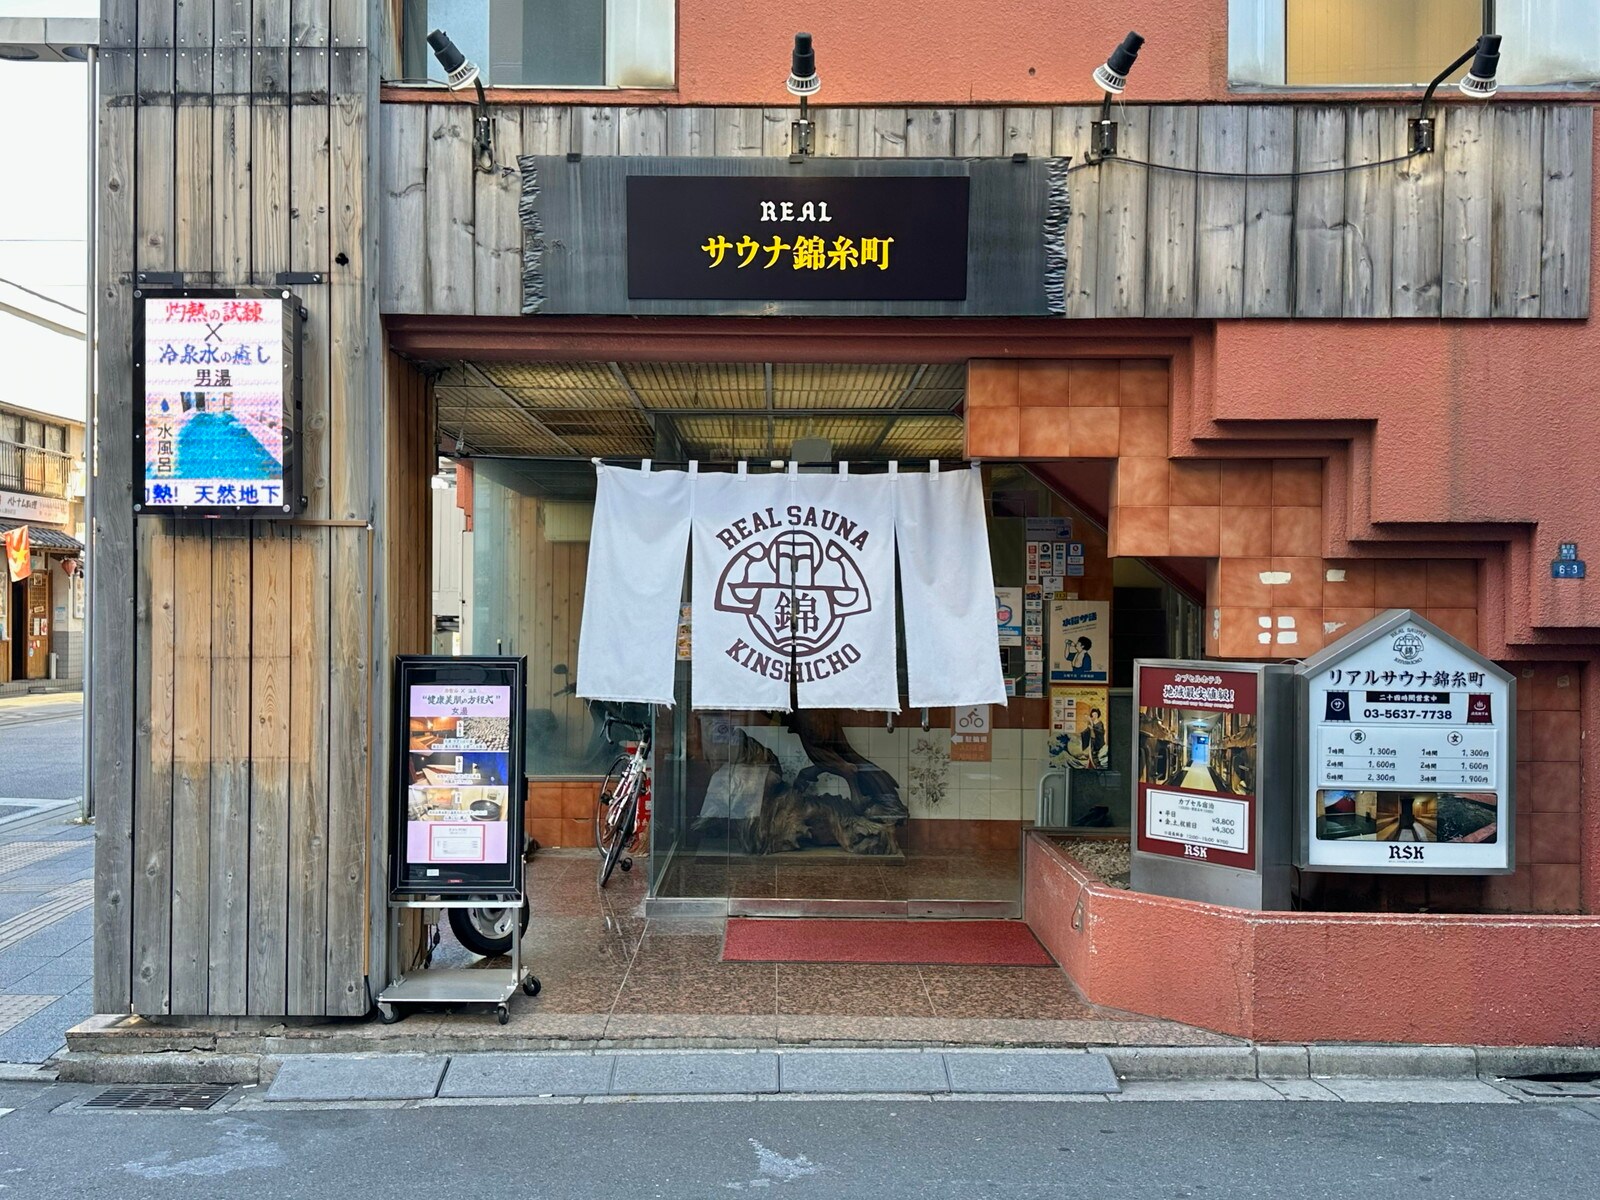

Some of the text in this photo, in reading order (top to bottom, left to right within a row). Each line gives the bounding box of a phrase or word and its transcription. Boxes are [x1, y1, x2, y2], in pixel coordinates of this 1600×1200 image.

[760, 201, 832, 223] REAL
[701, 235, 894, 271] サウナ錦糸町
[165, 301, 263, 322] 灼熱の試練
[159, 343, 270, 365] 冷泉水の癒し
[195, 369, 232, 387] 男湯
[157, 424, 173, 473] 水風呂
[194, 484, 280, 504] 天然地下
[716, 506, 869, 551] REAL SAUNA
[1559, 565, 1578, 574] 6-3
[774, 591, 819, 634] 錦
[725, 638, 861, 683] KINSHICHO
[1329, 669, 1486, 689] リアルサウナ錦糸町
[1379, 694, 1438, 702] 二十四時間営業中
[1363, 708, 1452, 720] 03-5637-7738
[1328, 747, 1344, 755] 1時間
[1421, 748, 1438, 756] 1時間
[1326, 760, 1343, 768] 2時間
[1326, 772, 1343, 781] 6時間
[1178, 798, 1215, 809] カプセル宿泊
[1212, 818, 1235, 827] ¥3,800
[1184, 844, 1208, 858] RSK
[1389, 845, 1424, 860] RSK
